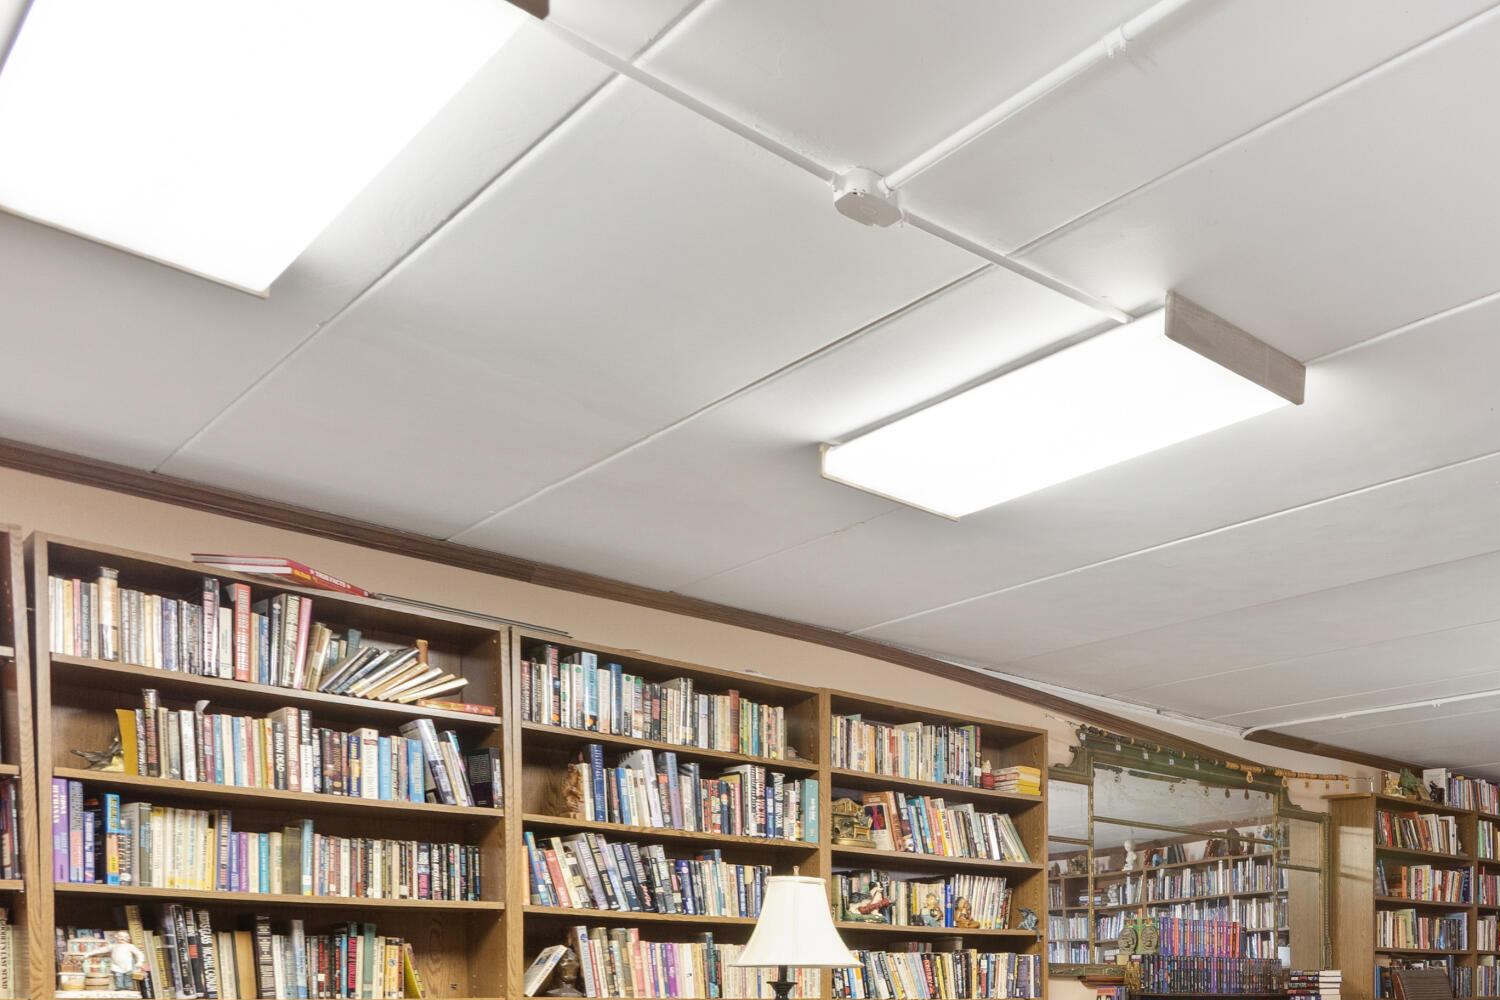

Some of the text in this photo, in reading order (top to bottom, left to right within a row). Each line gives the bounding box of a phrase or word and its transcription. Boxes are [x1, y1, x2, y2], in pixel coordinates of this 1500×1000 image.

[275, 732, 286, 772] BRAIN DEAD
[52, 784, 60, 824] BUCHANAN
[433, 863, 441, 892] BUCHANAN
[199, 928, 213, 945] GLASS
[202, 946, 216, 969] MICHAEL
